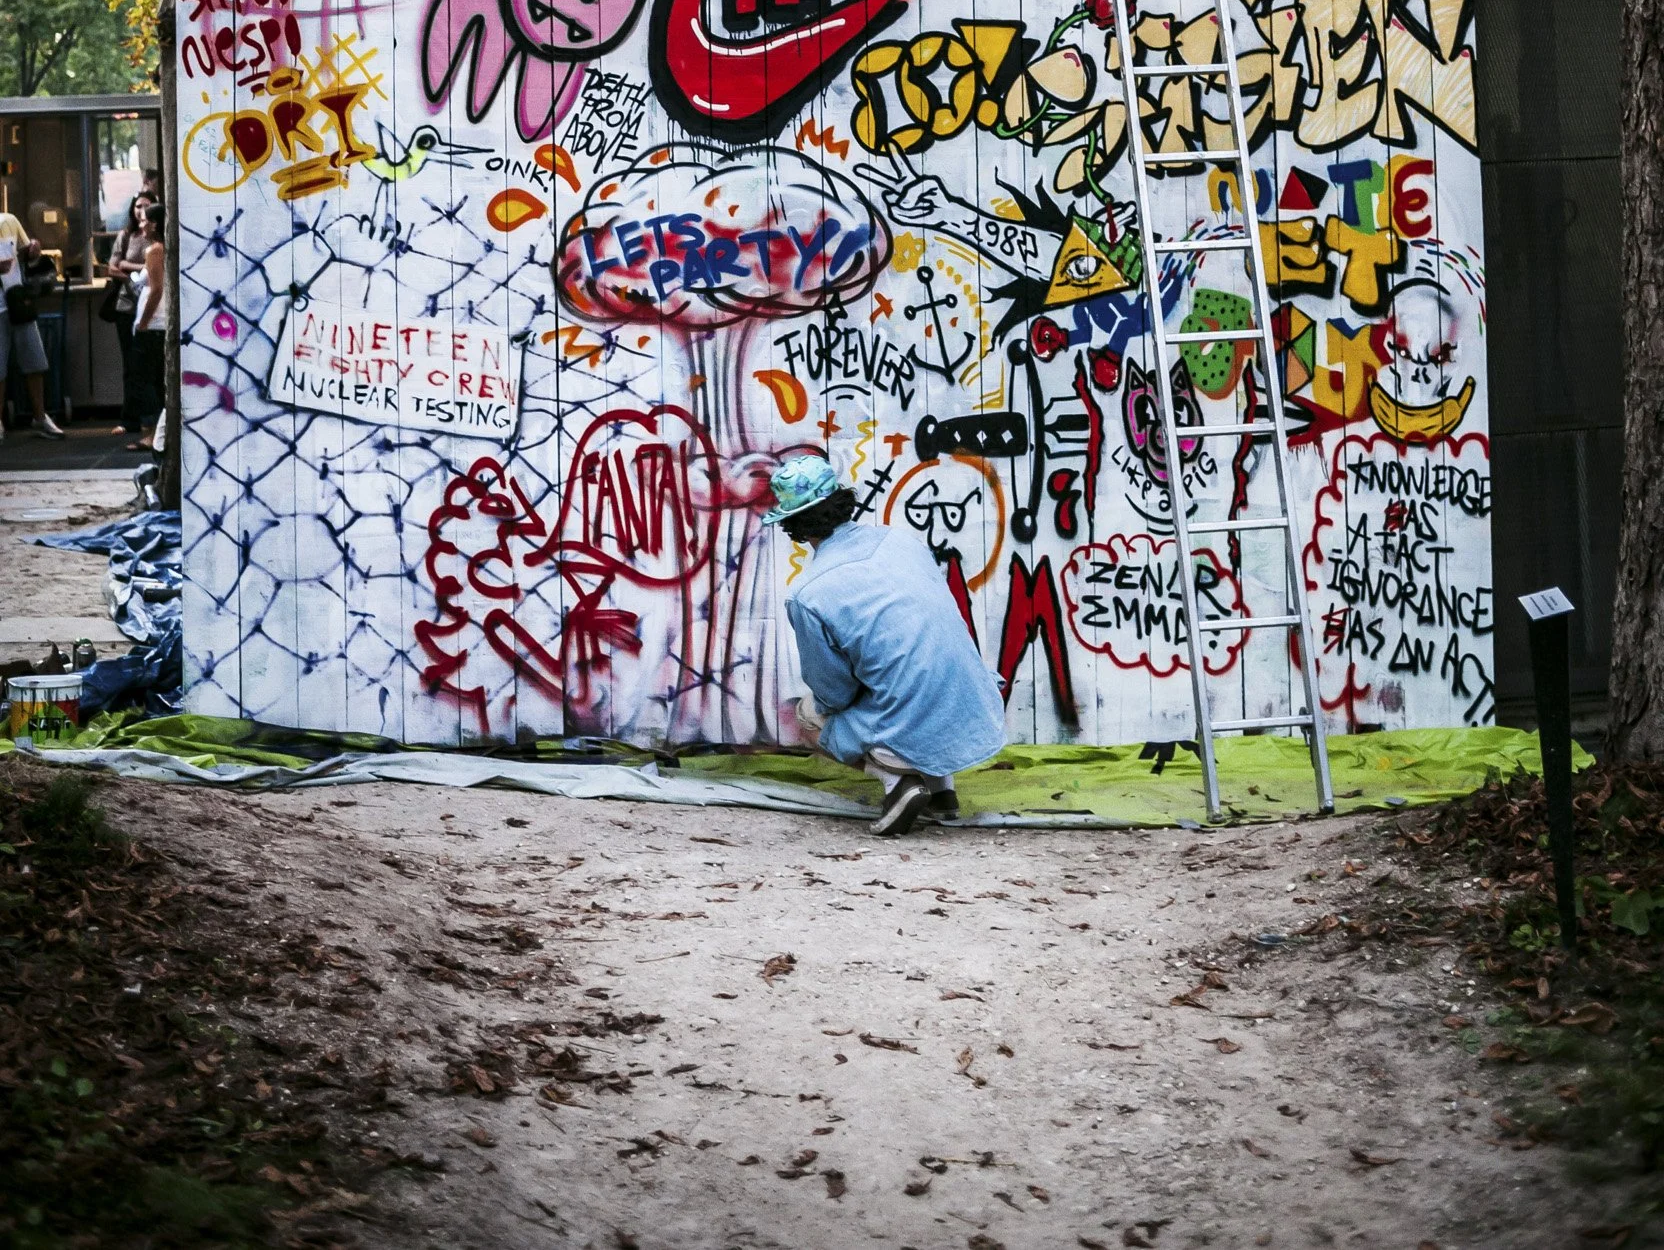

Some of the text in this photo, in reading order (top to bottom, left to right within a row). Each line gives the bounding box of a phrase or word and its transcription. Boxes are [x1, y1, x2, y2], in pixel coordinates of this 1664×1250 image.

[581, 67, 653, 114] DEATH
[581, 93, 645, 140] FROM
[560, 113, 638, 174] ABOVE
[303, 313, 500, 370] NINETEEN
[773, 323, 915, 411] FOREVER
[283, 365, 511, 428] NUCLEAR TESTING
[427, 369, 517, 406] CREW
[1347, 453, 1493, 517] KNOWLEDGE
[1347, 513, 1371, 569] A
[1327, 556, 1494, 636] IGNORANCE
[1388, 632, 1435, 676] AN
